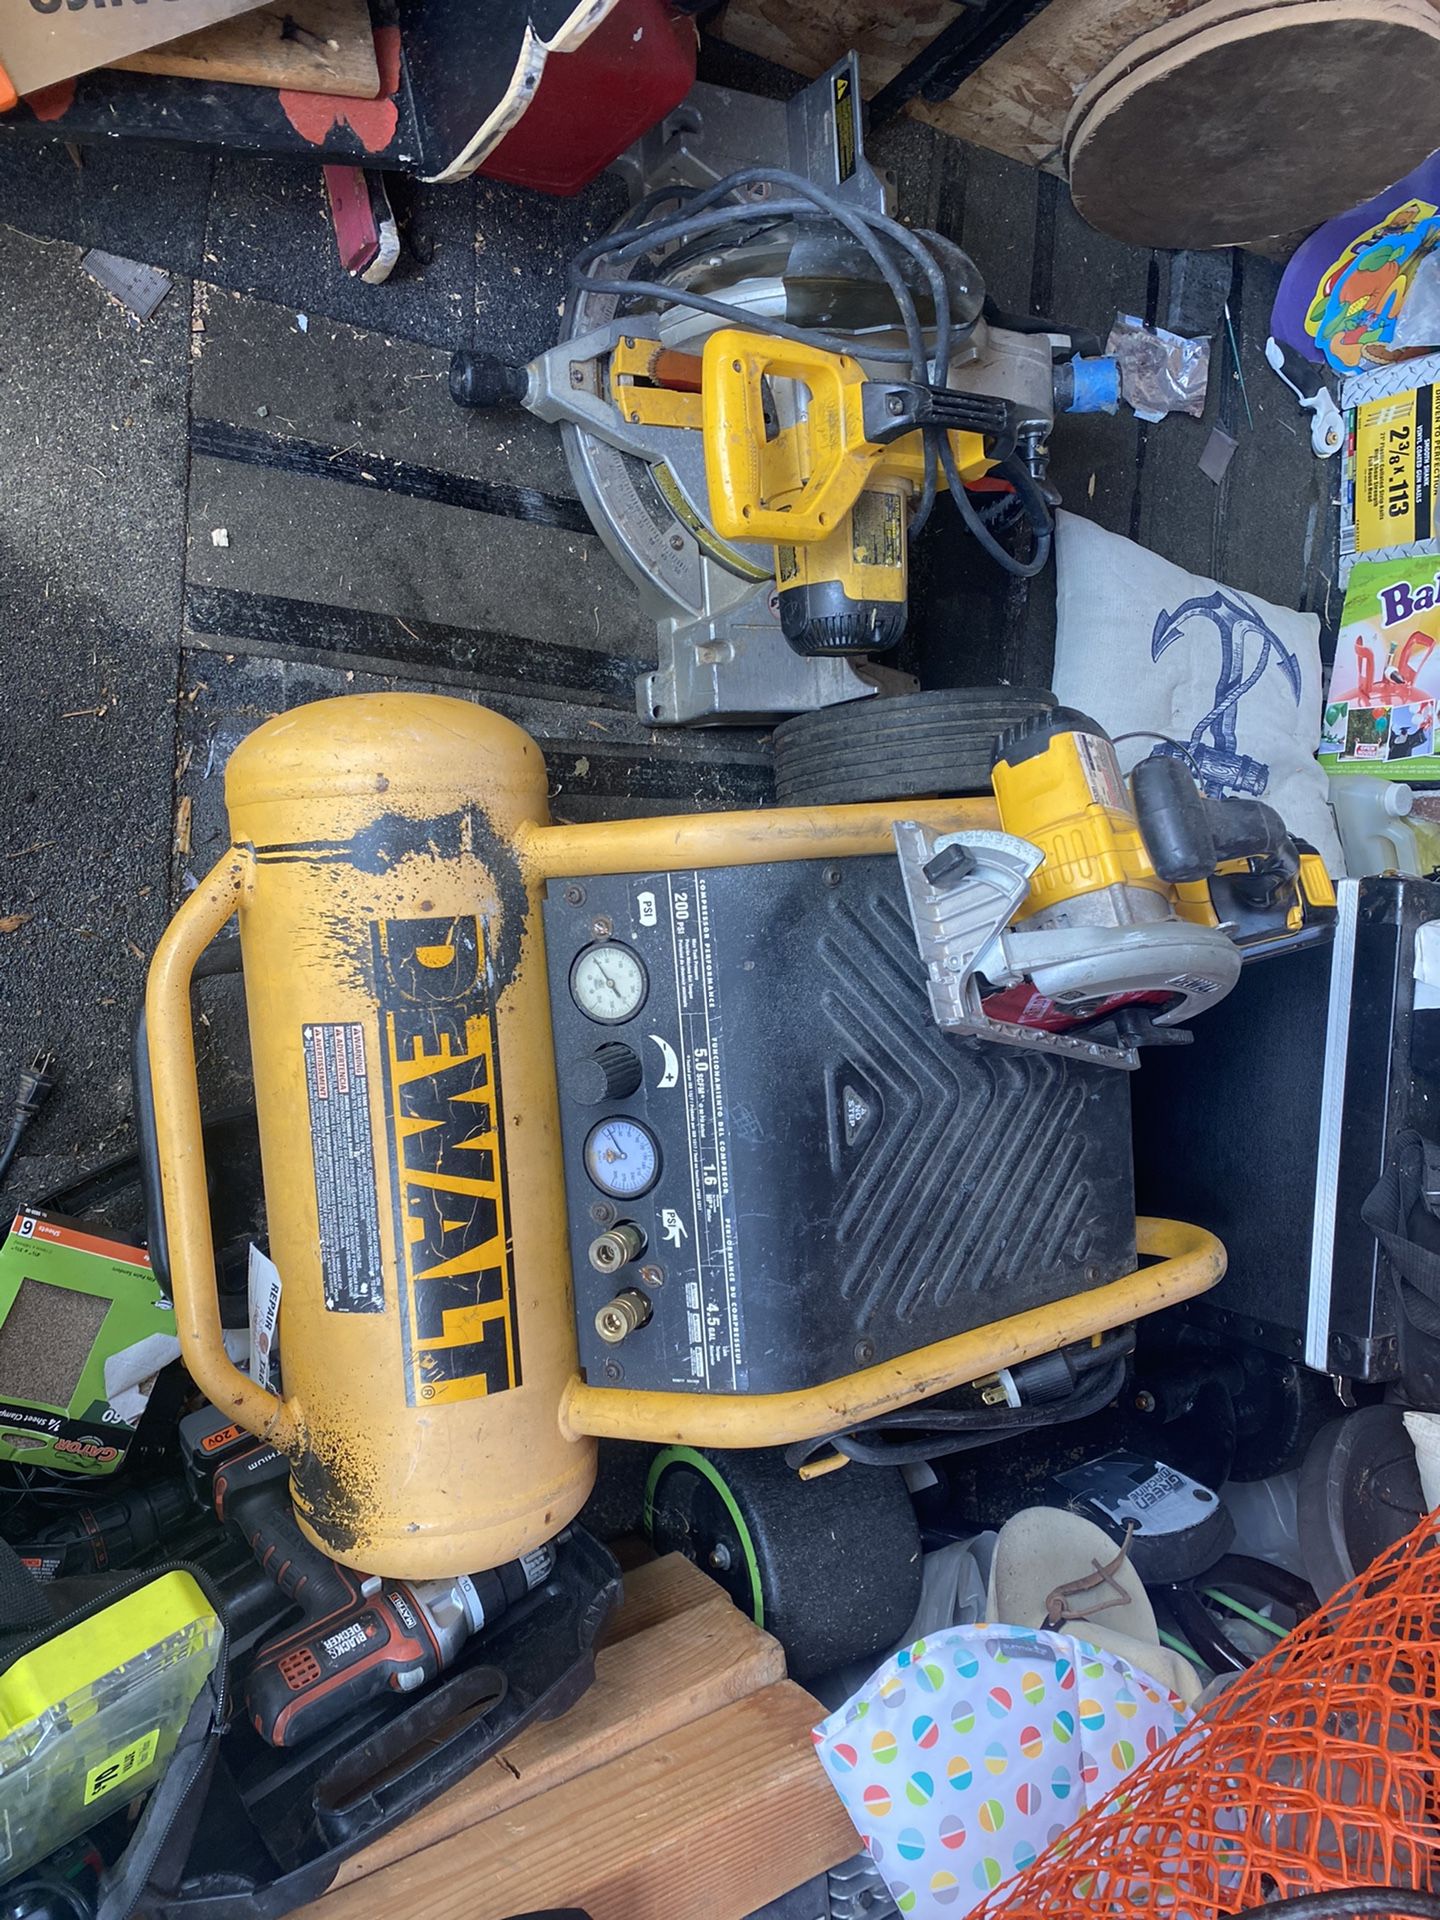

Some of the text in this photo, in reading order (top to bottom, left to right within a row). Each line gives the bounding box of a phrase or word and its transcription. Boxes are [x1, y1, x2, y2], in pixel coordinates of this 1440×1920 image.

[1389, 477, 1409, 517] .113
[1381, 575, 1440, 627] Ba
[643, 900, 653, 918] PSI
[674, 893, 689, 935] 200 PSI
[700, 879, 715, 1007] COMPRESSOR PERFORMANCE
[316, 1038, 326, 1096] AVERTISSEMENT
[337, 1039, 346, 1090] ADVERTENCIA
[354, 1036, 363, 1073] WARNING
[694, 1048, 709, 1071] 5.0
[712, 1037, 723, 1117] FUNCIONAMIENTO
[719, 1141, 729, 1194] COMPRESOR
[855, 1105, 861, 1121] NO
[384, 915, 509, 1395] DEWALT
[703, 1164, 718, 1186] 1.6
[21, 1220, 61, 1237] Sheets 6
[667, 1212, 677, 1227] PSI
[264, 1283, 280, 1331] REPAIR
[725, 1218, 741, 1365] PERFORMANCE DU COMPRESSEUR
[706, 1303, 720, 1341] 4.5 GAL
[258, 1359, 266, 1384] TAG
[23, 1414, 48, 1426] Sheet
[102, 1408, 122, 1424] 60
[54, 1438, 118, 1463] GATOR
[247, 1449, 282, 1471] THIUM
[1129, 1468, 1171, 1501] MACHINE
[1135, 1474, 1182, 1510] GREEN
[462, 1578, 471, 1592] 10
[323, 1623, 361, 1650] DECKER
